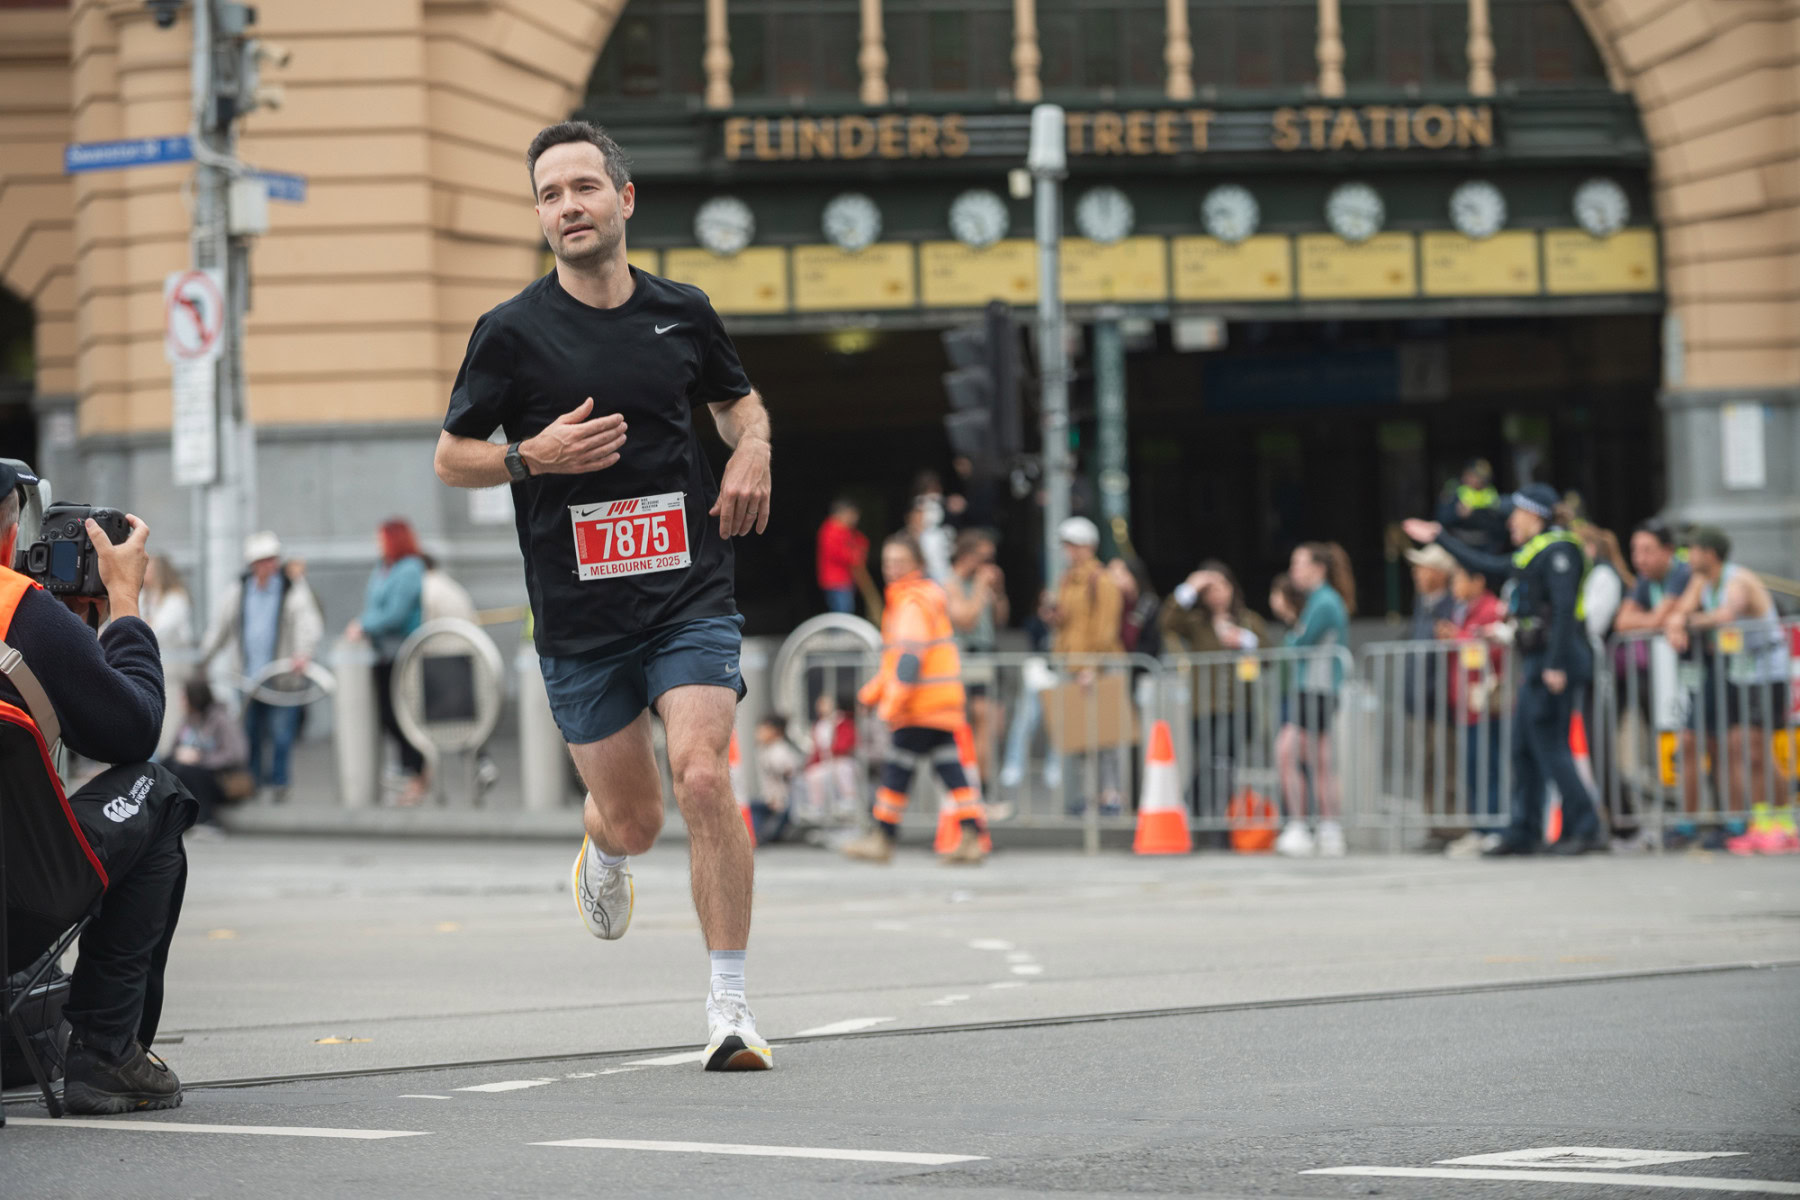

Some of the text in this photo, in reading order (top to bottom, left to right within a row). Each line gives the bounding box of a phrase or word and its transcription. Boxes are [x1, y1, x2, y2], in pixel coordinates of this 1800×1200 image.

[724, 104, 1494, 160] FLINDERS TREET STATION
[596, 515, 670, 560] 7875
[590, 556, 681, 576] MELBOURNE 2025
